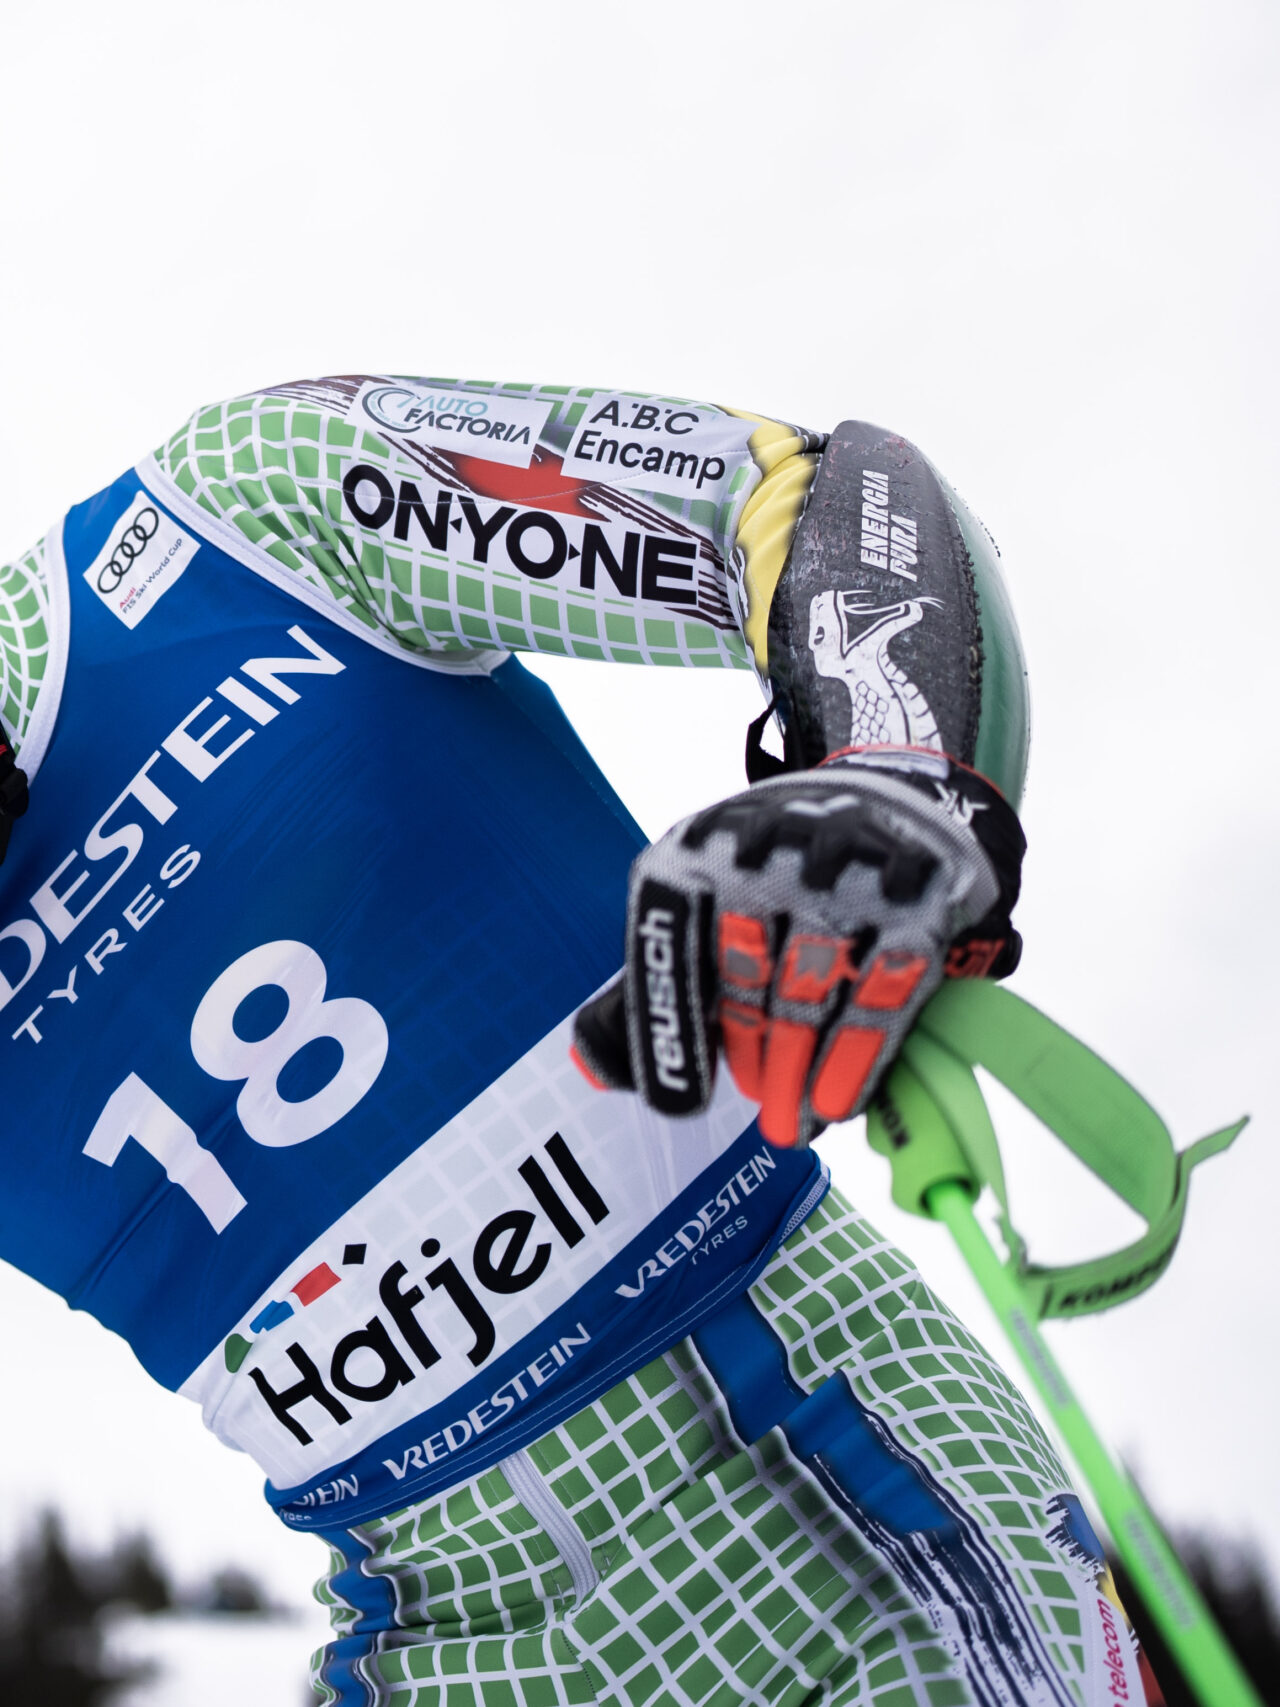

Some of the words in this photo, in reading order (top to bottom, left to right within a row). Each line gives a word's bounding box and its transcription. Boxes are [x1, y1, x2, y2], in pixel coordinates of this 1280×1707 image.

[403, 408, 531, 445] FACTORIA
[415, 395, 489, 417] AUTO
[574, 429, 726, 489] Encamp
[860, 469, 889, 570] ENERGIA
[890, 513, 918, 583] PURA
[119, 587, 136, 609] Audi
[122, 598, 137, 615] FIS
[135, 583, 148, 599] Ski
[145, 556, 170, 583] World
[168, 537, 183, 556] Cup
[11, 843, 202, 1044] TYRES
[639, 907, 689, 1091] reusch
[81, 939, 390, 1236] 18
[614, 1145, 777, 1299] VREDESTEIN
[691, 1215, 748, 1265] TYRES
[248, 1131, 611, 1446] Hafjell
[381, 1322, 592, 1480] VREDESTEIN
[1096, 1598, 1129, 1701] telecom
